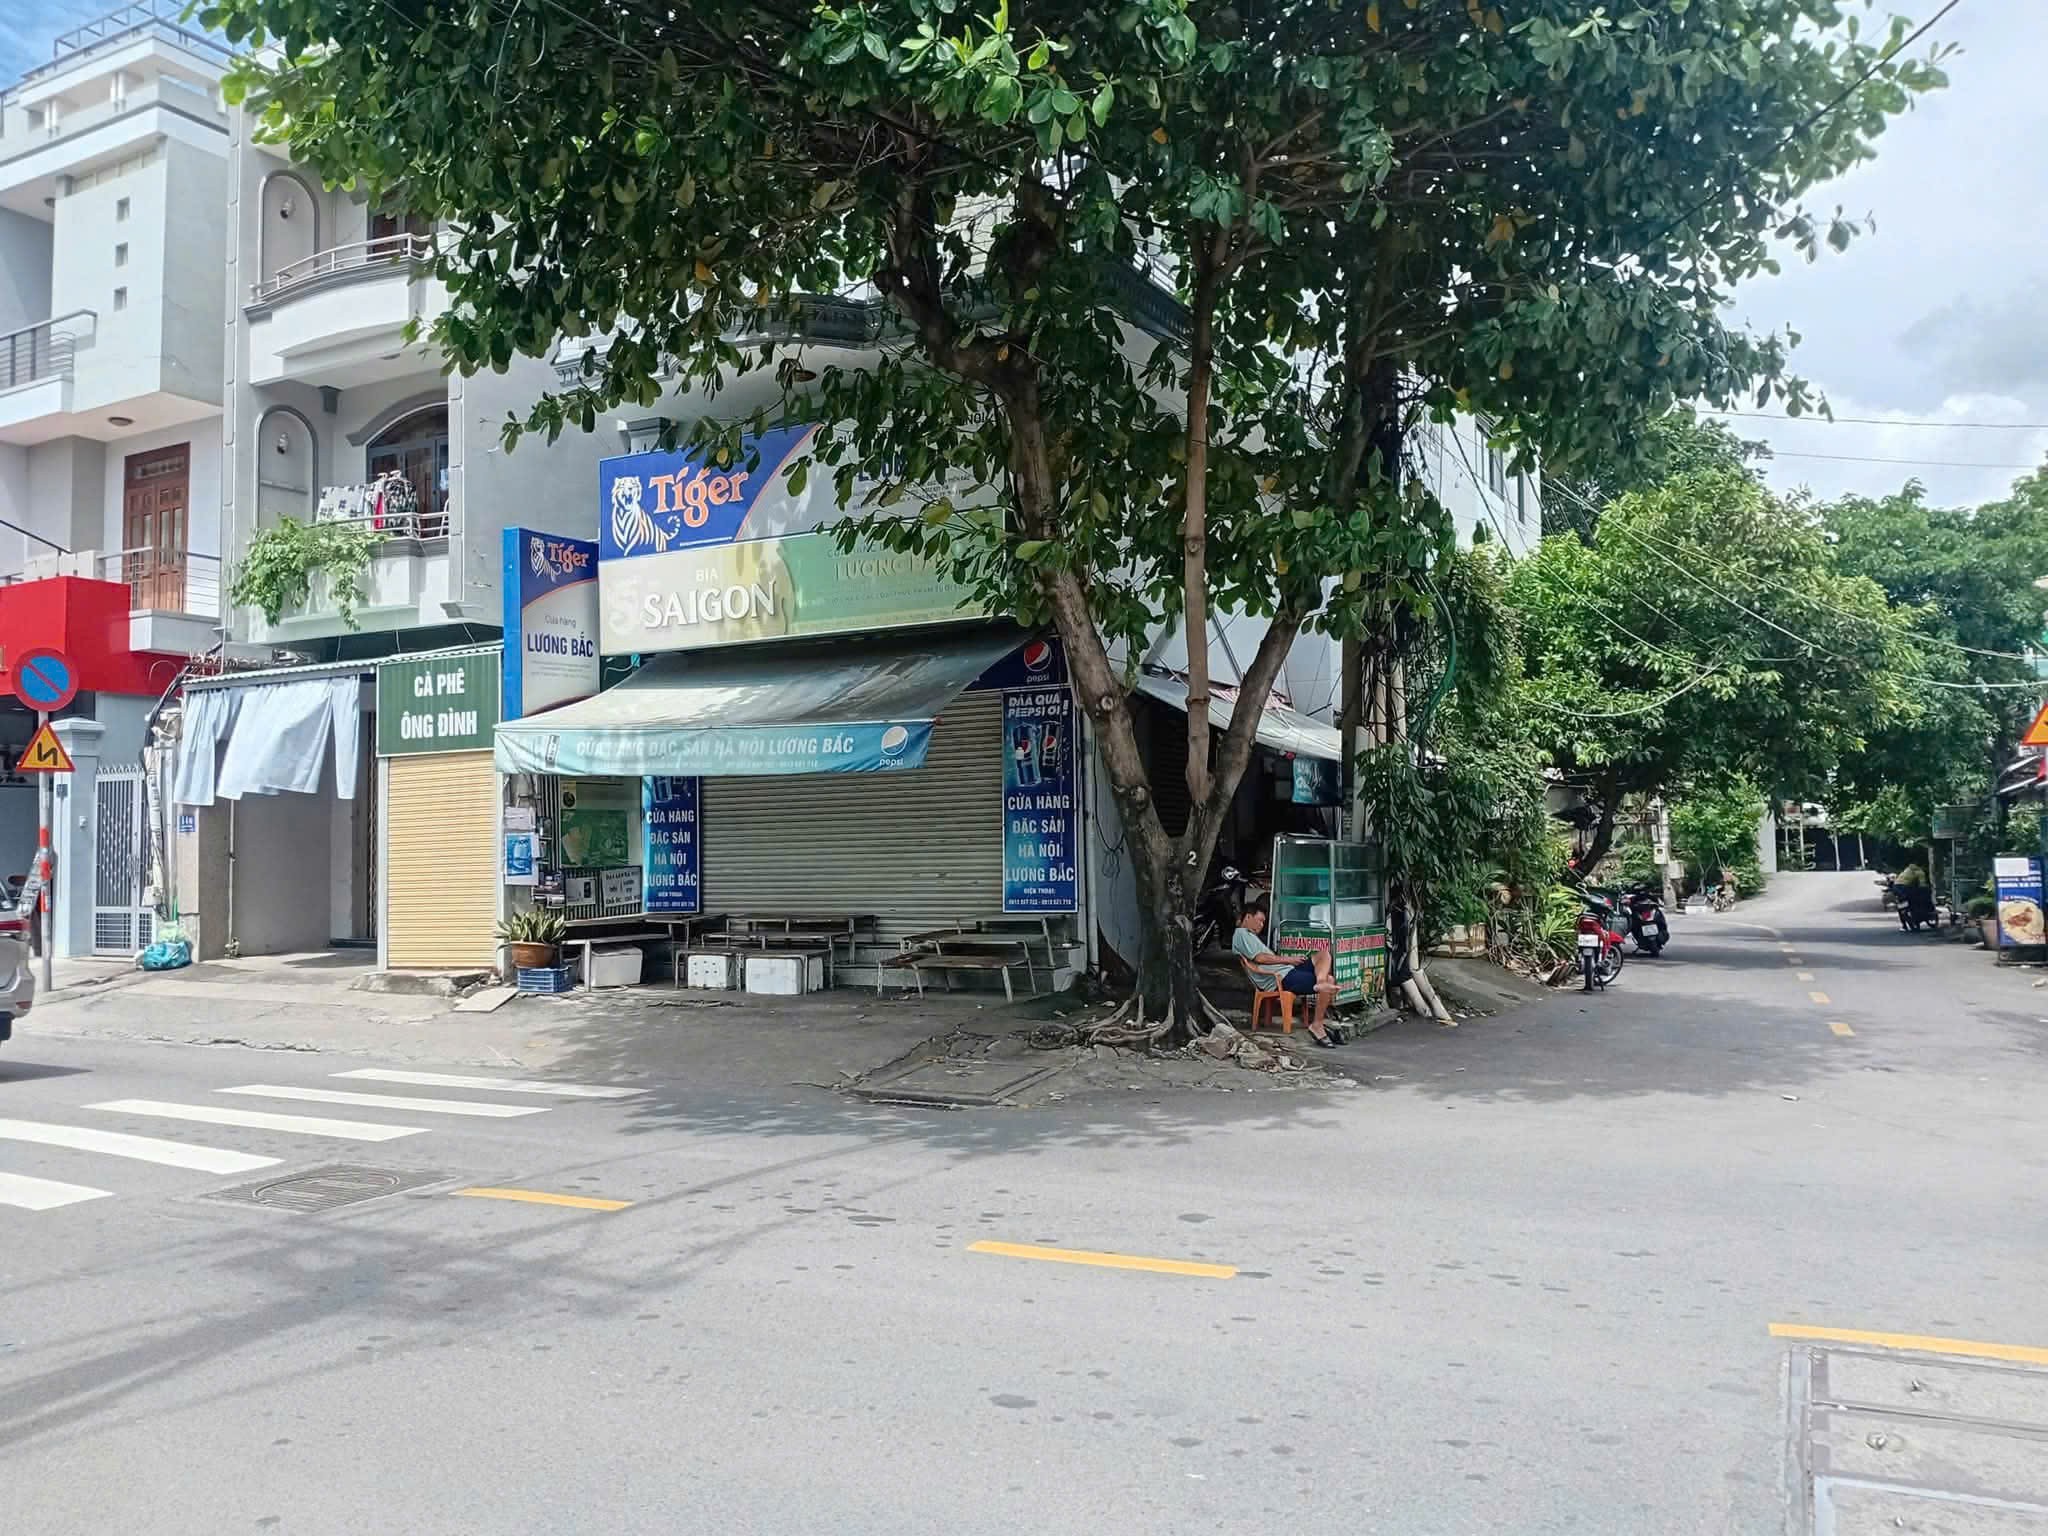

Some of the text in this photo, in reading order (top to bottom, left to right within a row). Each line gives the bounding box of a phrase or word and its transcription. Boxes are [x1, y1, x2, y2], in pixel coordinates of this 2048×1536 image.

[649, 467, 749, 528] Tiger
[547, 542, 589, 574] Tiger
[696, 566, 719, 582] BIA
[645, 575, 777, 629] SAIGON
[527, 631, 594, 658] LƯƠNG BẮC
[414, 667, 465, 698] CÀ PHÊ
[1026, 674, 1050, 685] pepsi
[401, 707, 478, 740] ÔNG ĐÌNH
[770, 736, 818, 756] LƯƠNG
[822, 732, 855, 754] BẮC
[880, 758, 904, 768] pepsi
[1008, 791, 1070, 810] CỬA HÀNG
[646, 807, 695, 824] CỬA HÀNG
[1012, 815, 1065, 837] ĐẶC SẢN
[650, 827, 691, 847] ĐẶC SẢN
[670, 849, 687, 868] NỘI
[1018, 840, 1061, 861] HÀ NỘI
[1187, 850, 1198, 866] 2
[678, 868, 697, 887] BẮC
[1005, 862, 1075, 882] LƯƠNG BẮC
